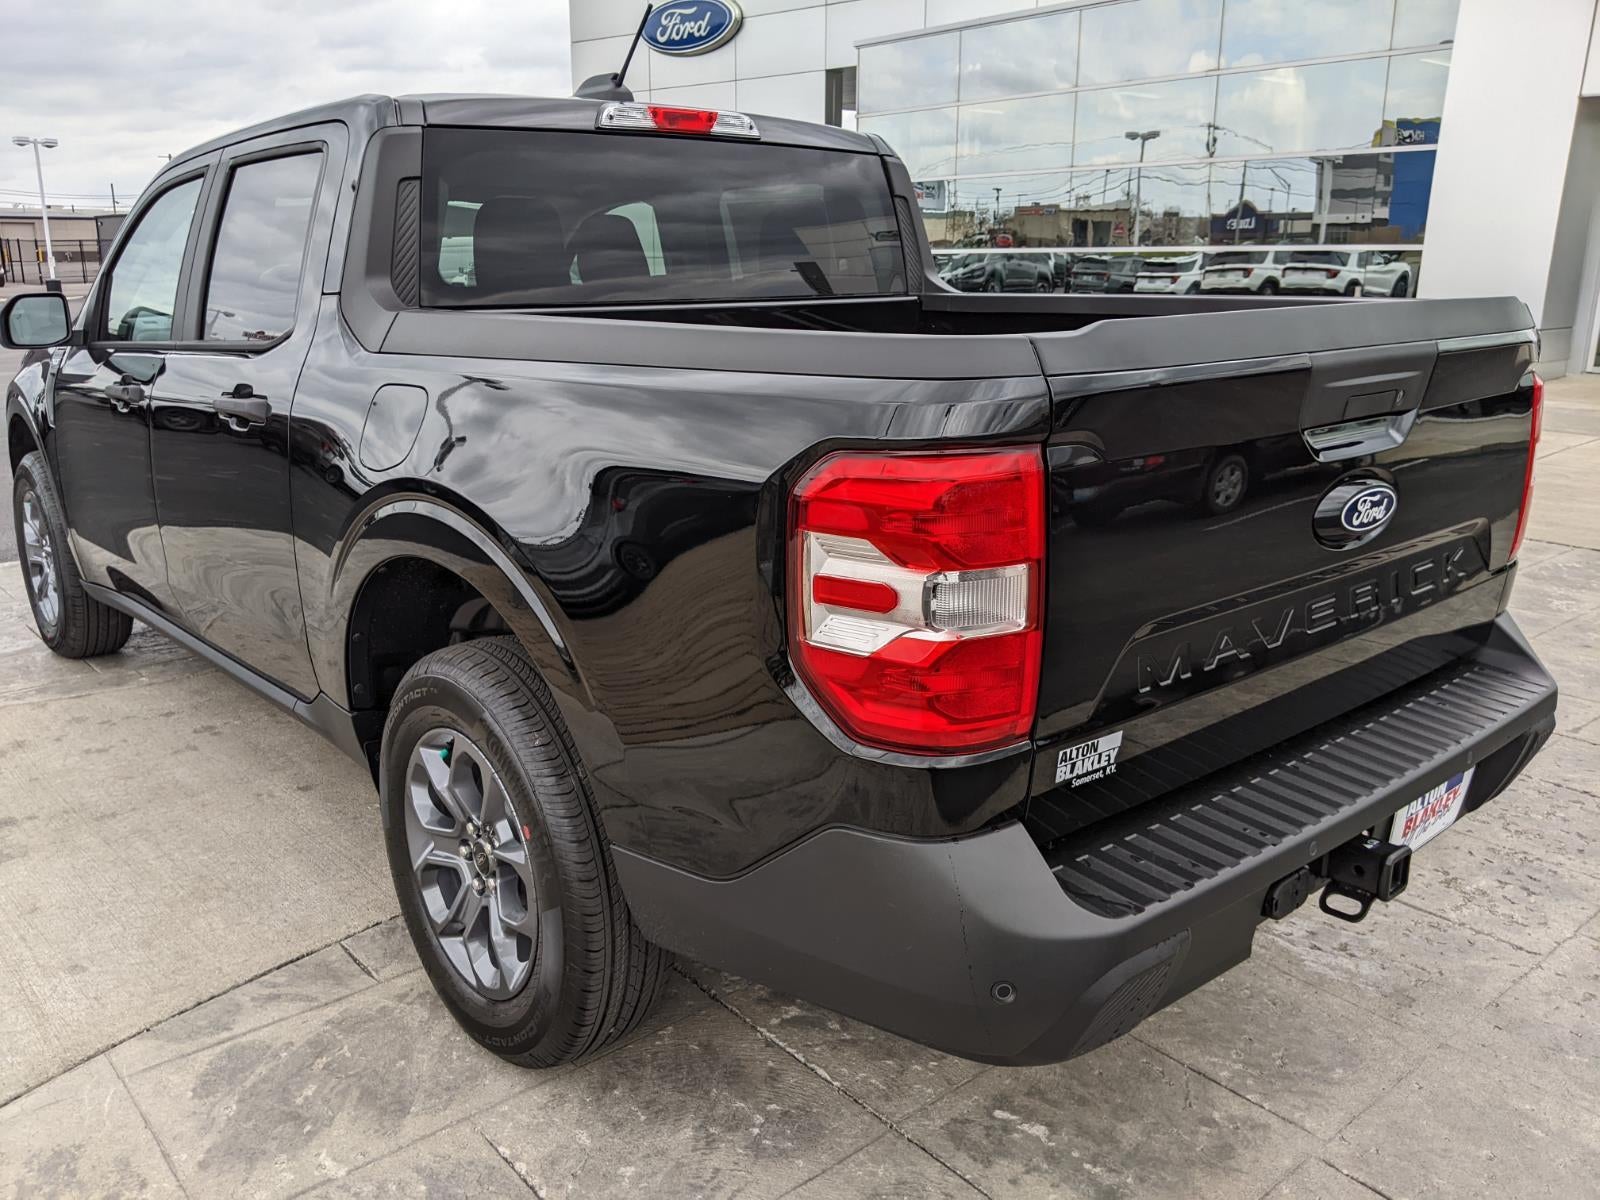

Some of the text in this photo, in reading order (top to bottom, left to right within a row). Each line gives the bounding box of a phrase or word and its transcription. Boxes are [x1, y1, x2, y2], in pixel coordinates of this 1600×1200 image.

[656, 6, 712, 43] Ford
[1352, 494, 1389, 526] Ford
[1136, 546, 1467, 694] MAVERICK
[1055, 746, 1120, 784] BLAKLEY
[1058, 740, 1100, 766] ALTON
